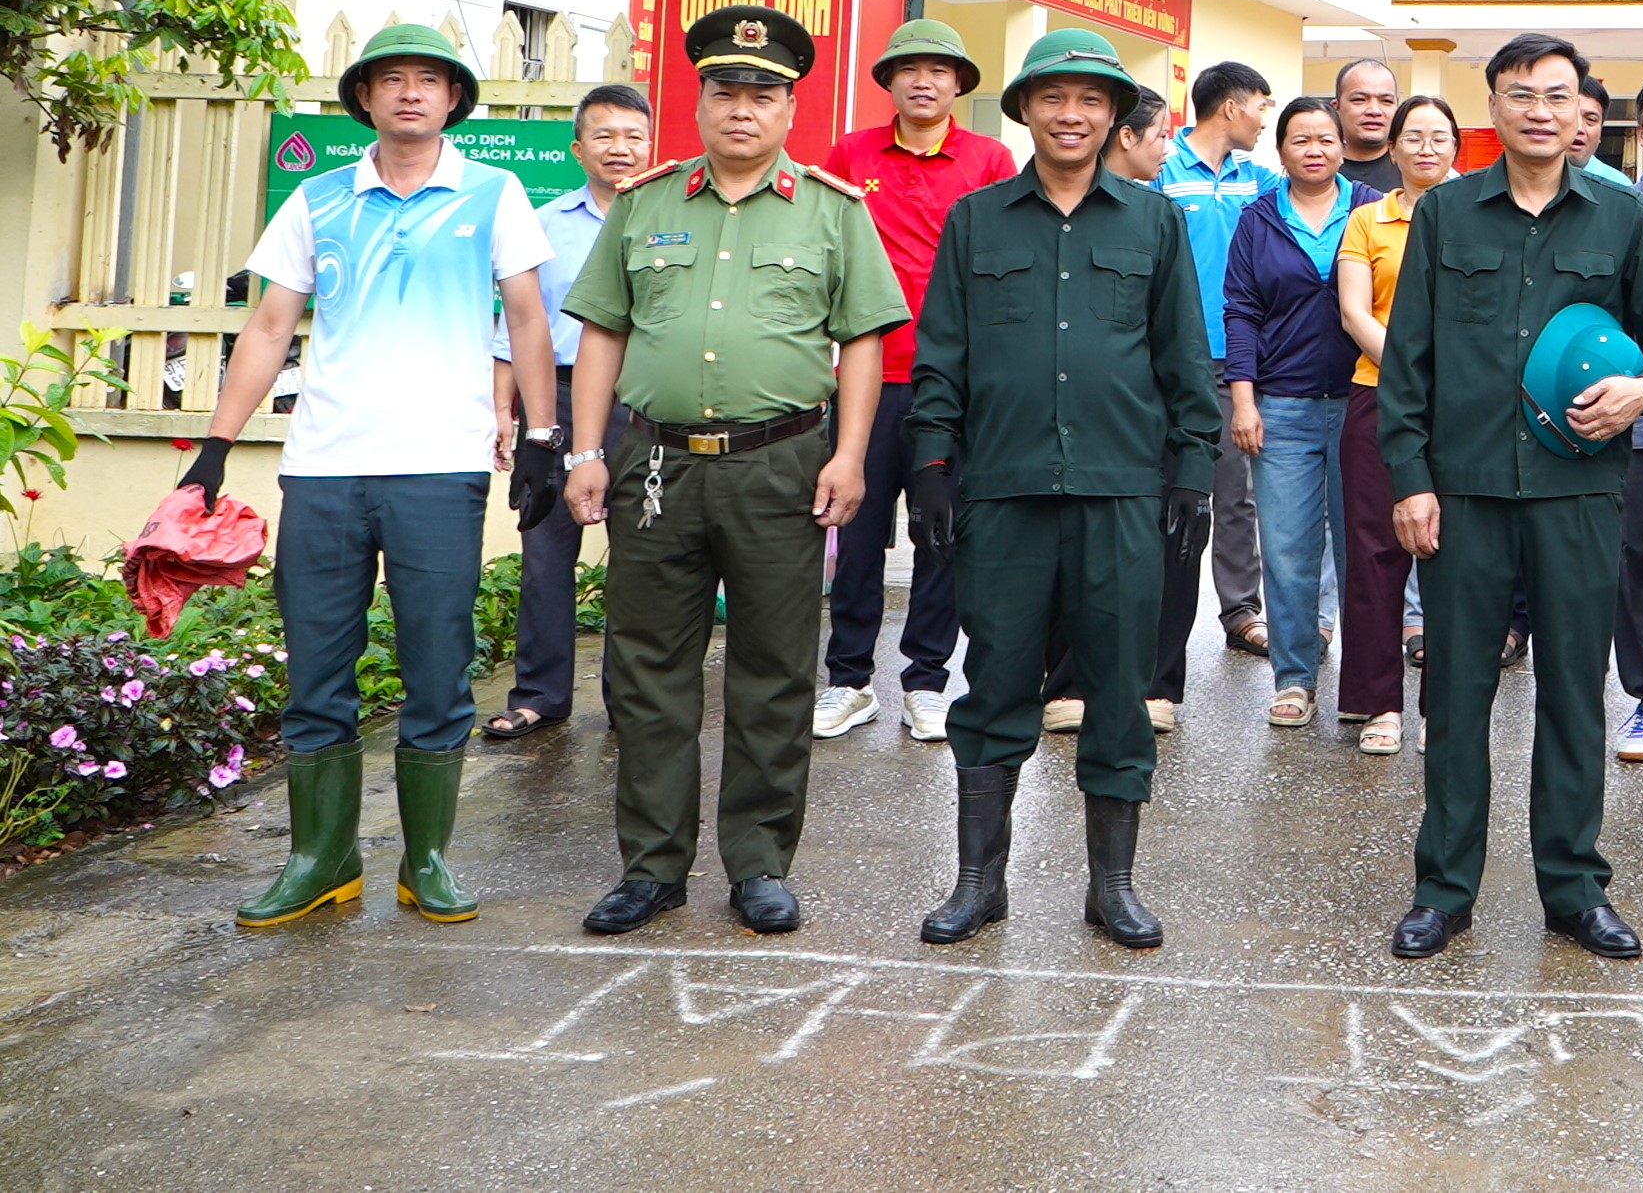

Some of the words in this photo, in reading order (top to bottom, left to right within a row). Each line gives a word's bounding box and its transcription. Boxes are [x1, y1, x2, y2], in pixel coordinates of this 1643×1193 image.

[480, 134, 515, 148] DỊCH
[470, 147, 511, 160] SÁCH
[514, 147, 535, 161] XÃ
[539, 149, 565, 164] HỘI
